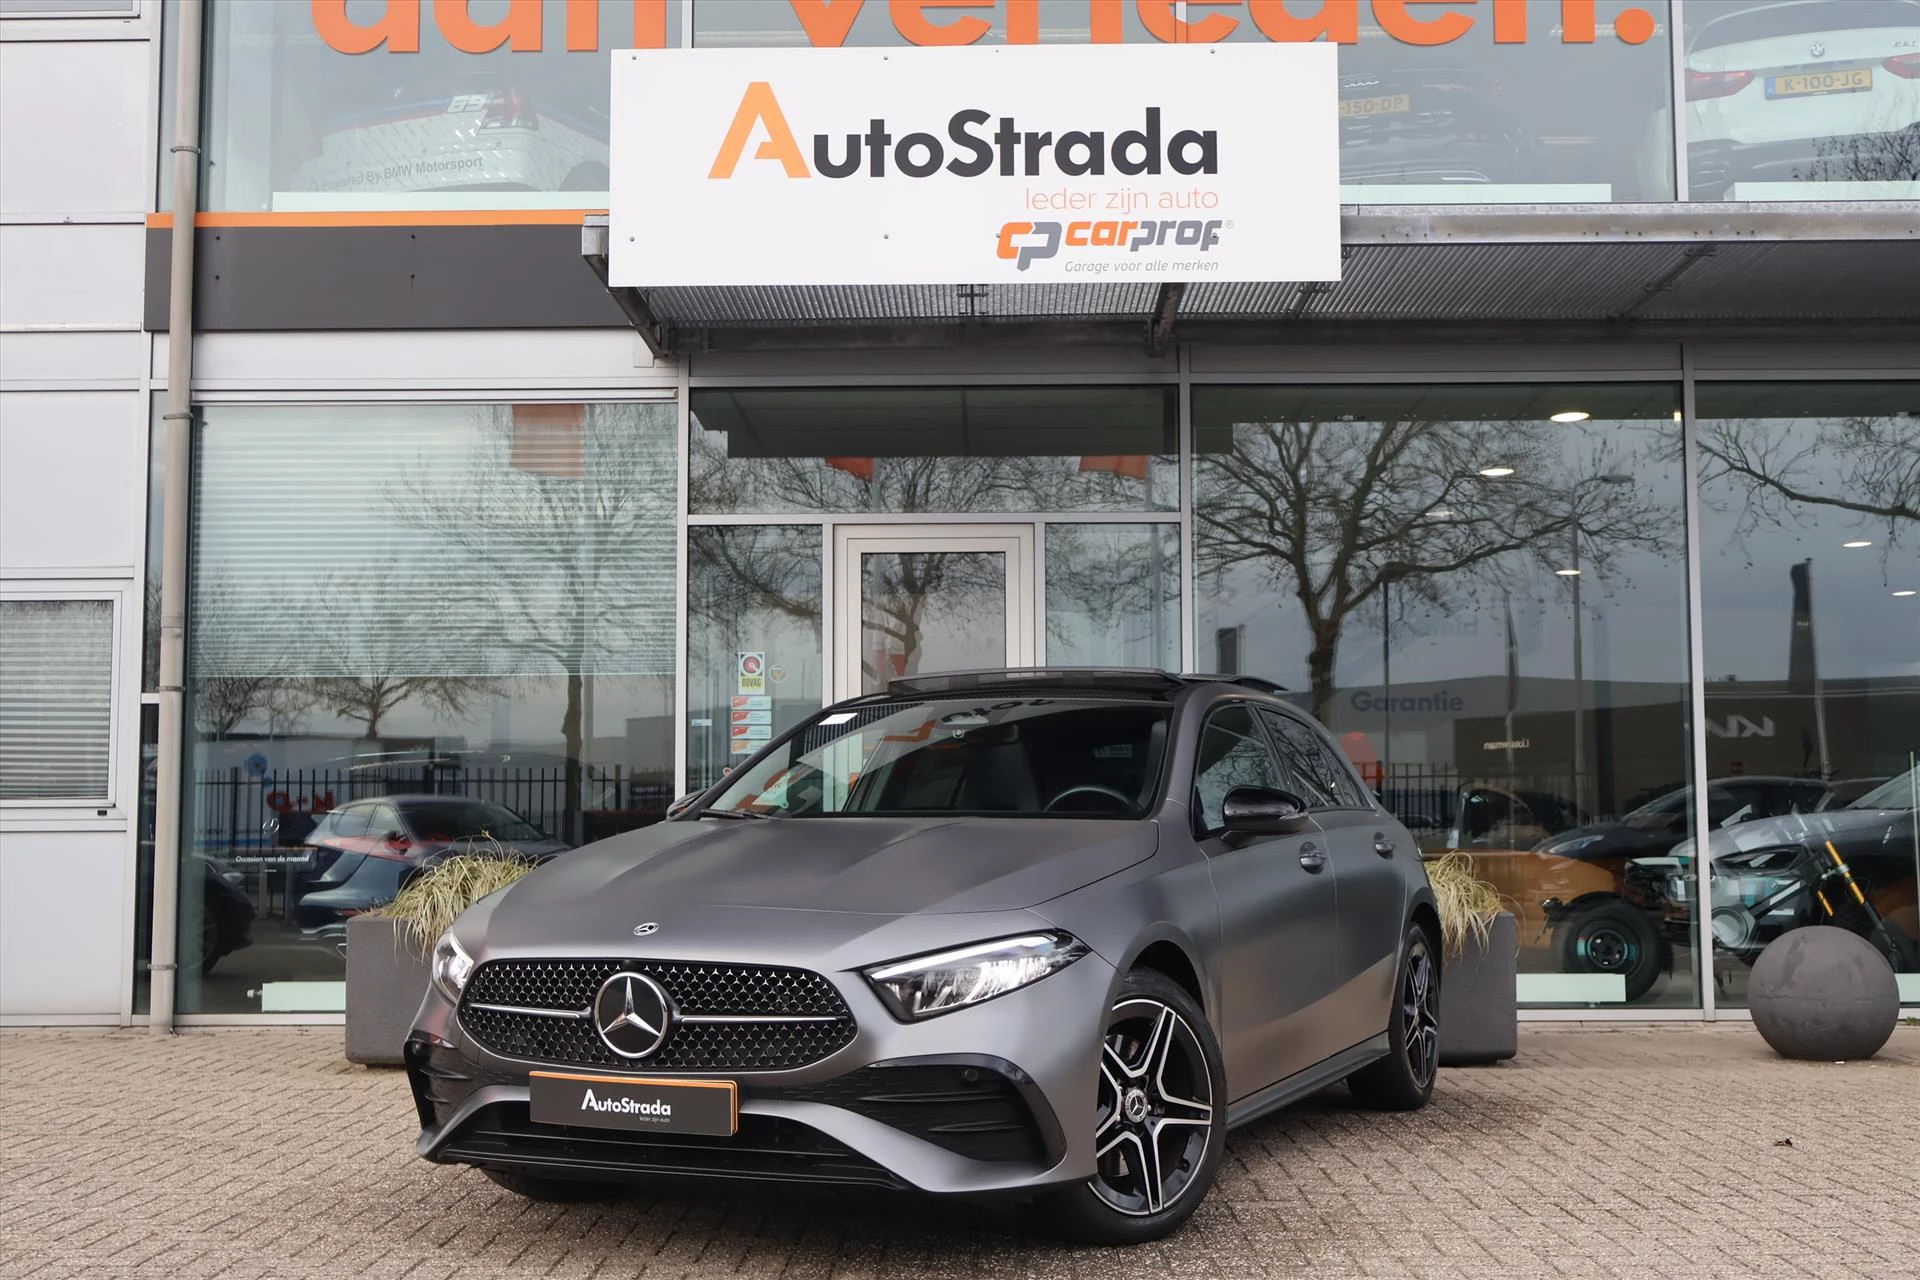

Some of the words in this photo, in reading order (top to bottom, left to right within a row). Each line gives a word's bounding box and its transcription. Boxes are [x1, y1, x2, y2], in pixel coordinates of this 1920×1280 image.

[1784, 72, 1863, 92] K-100-JG
[707, 81, 1219, 179] AutoStrada
[366, 170, 381, 184] By
[384, 164, 412, 179] BMW
[416, 156, 484, 174] Motorsport
[1025, 187, 1096, 210] Ieder
[1105, 188, 1148, 215] zijn
[1158, 190, 1219, 210] auto
[1065, 261, 1110, 274] Garage
[1114, 262, 1143, 272] voor
[1145, 261, 1169, 272] alle
[1172, 260, 1219, 271] merken
[742, 678, 762, 688] BOVAG
[1350, 690, 1464, 712] Garantie
[235, 855, 263, 863] Occasion
[277, 855, 286, 863] de
[287, 855, 310, 863] maand
[581, 1088, 671, 1115] AutoStrada
